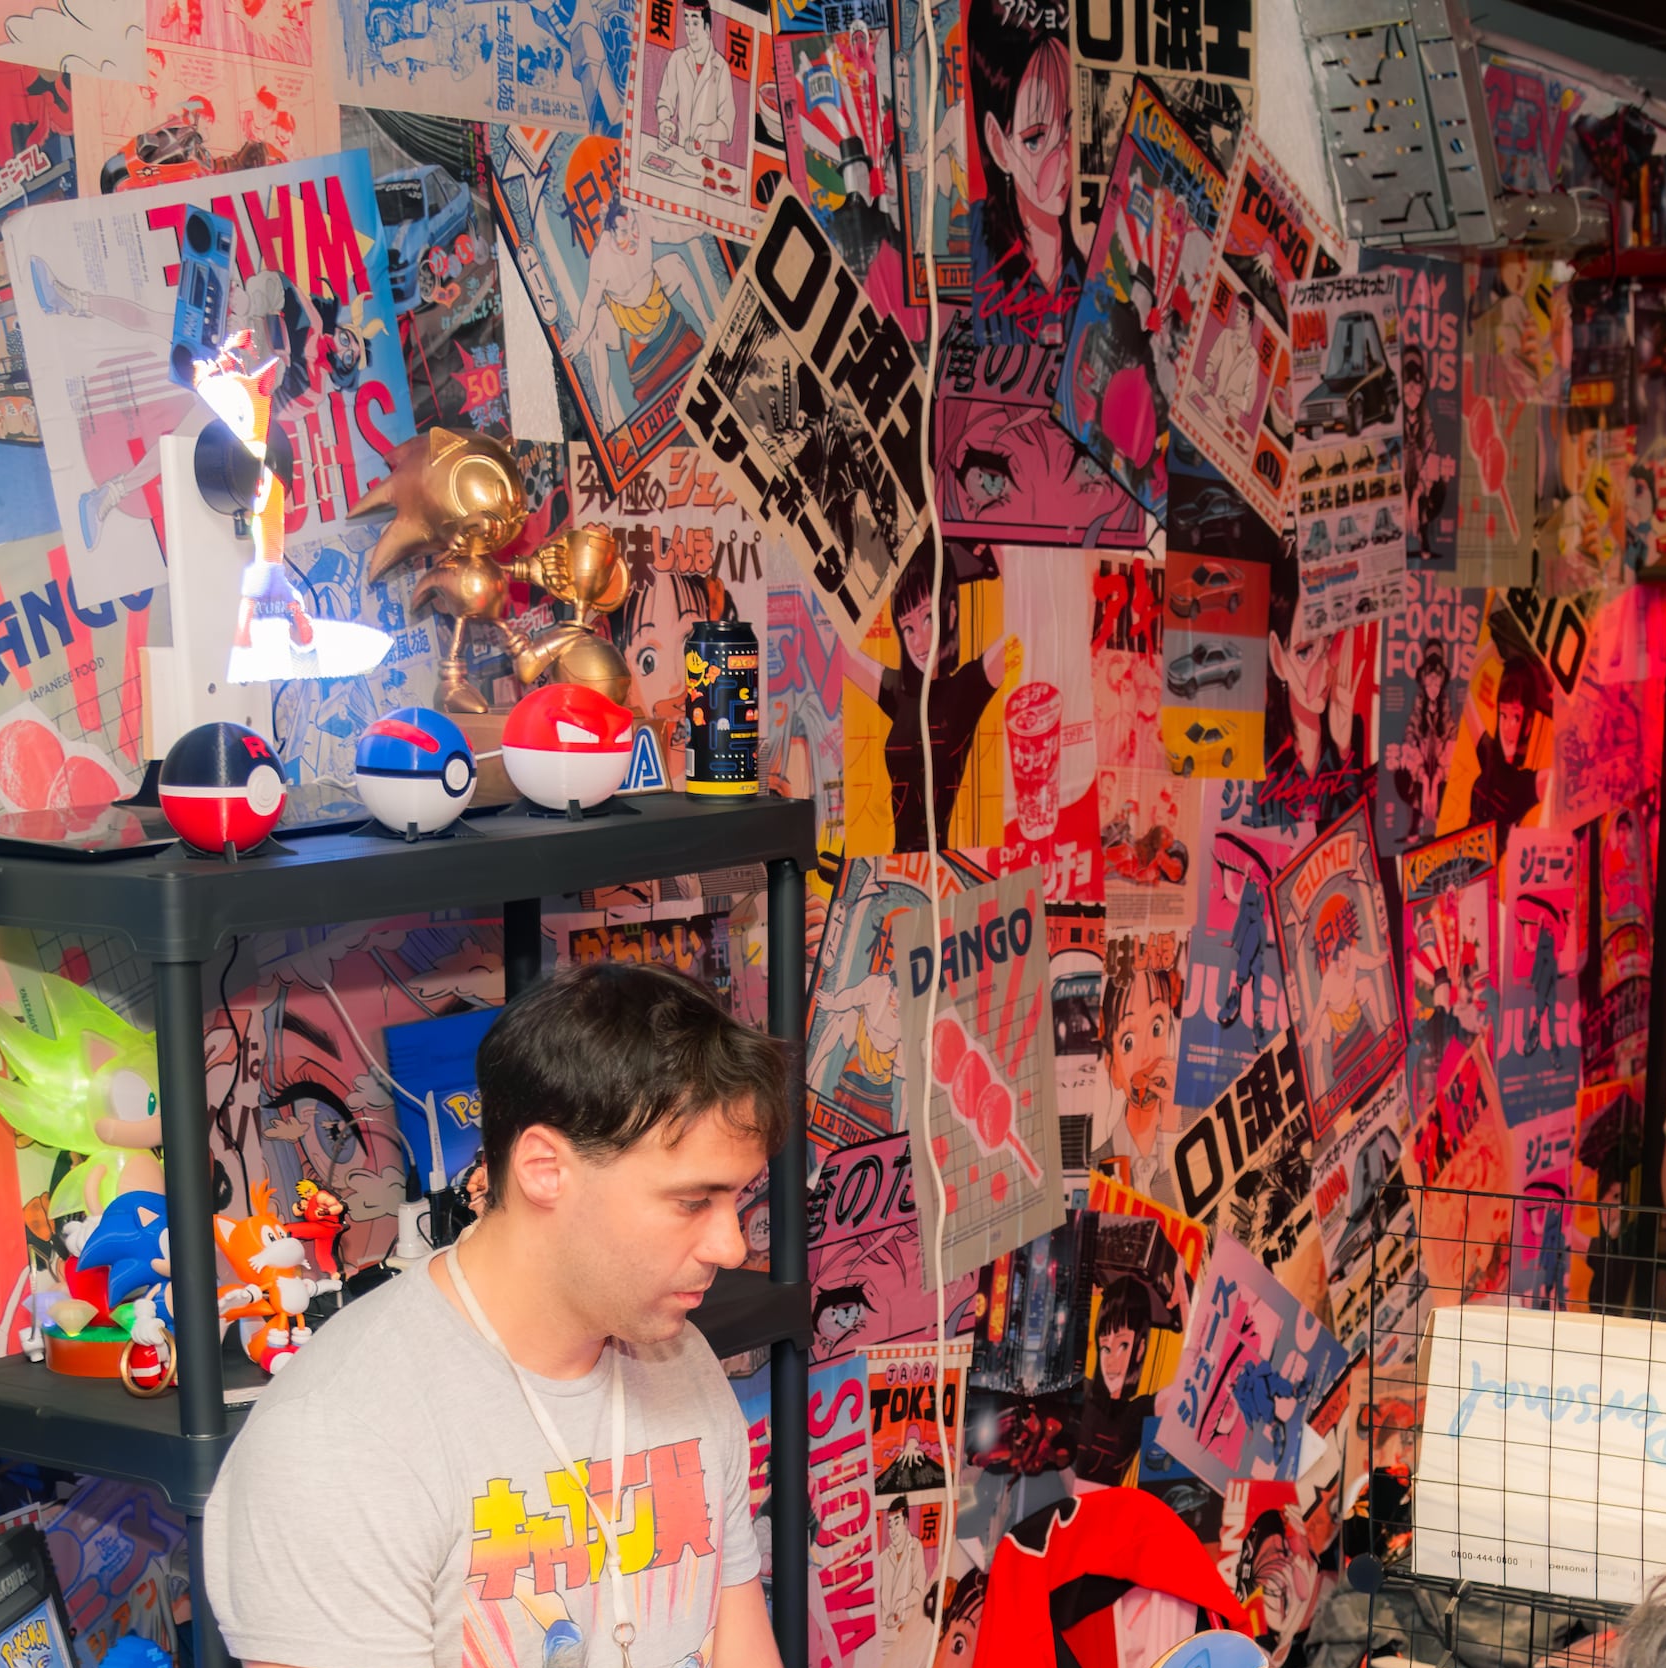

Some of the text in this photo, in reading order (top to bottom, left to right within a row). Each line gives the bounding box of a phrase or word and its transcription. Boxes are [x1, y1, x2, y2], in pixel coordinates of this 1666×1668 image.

[1237, 177, 1311, 281] TOKYO
[1387, 602, 1479, 643] FOCUS
[29, 656, 106, 702] JAPANESE FOOD
[1295, 838, 1351, 901] SUMO
[909, 908, 1033, 997] DANGO
[885, 1362, 935, 1386] JAPA
[870, 1384, 955, 1434] TOKYO
[921, 1507, 940, 1541] 京
